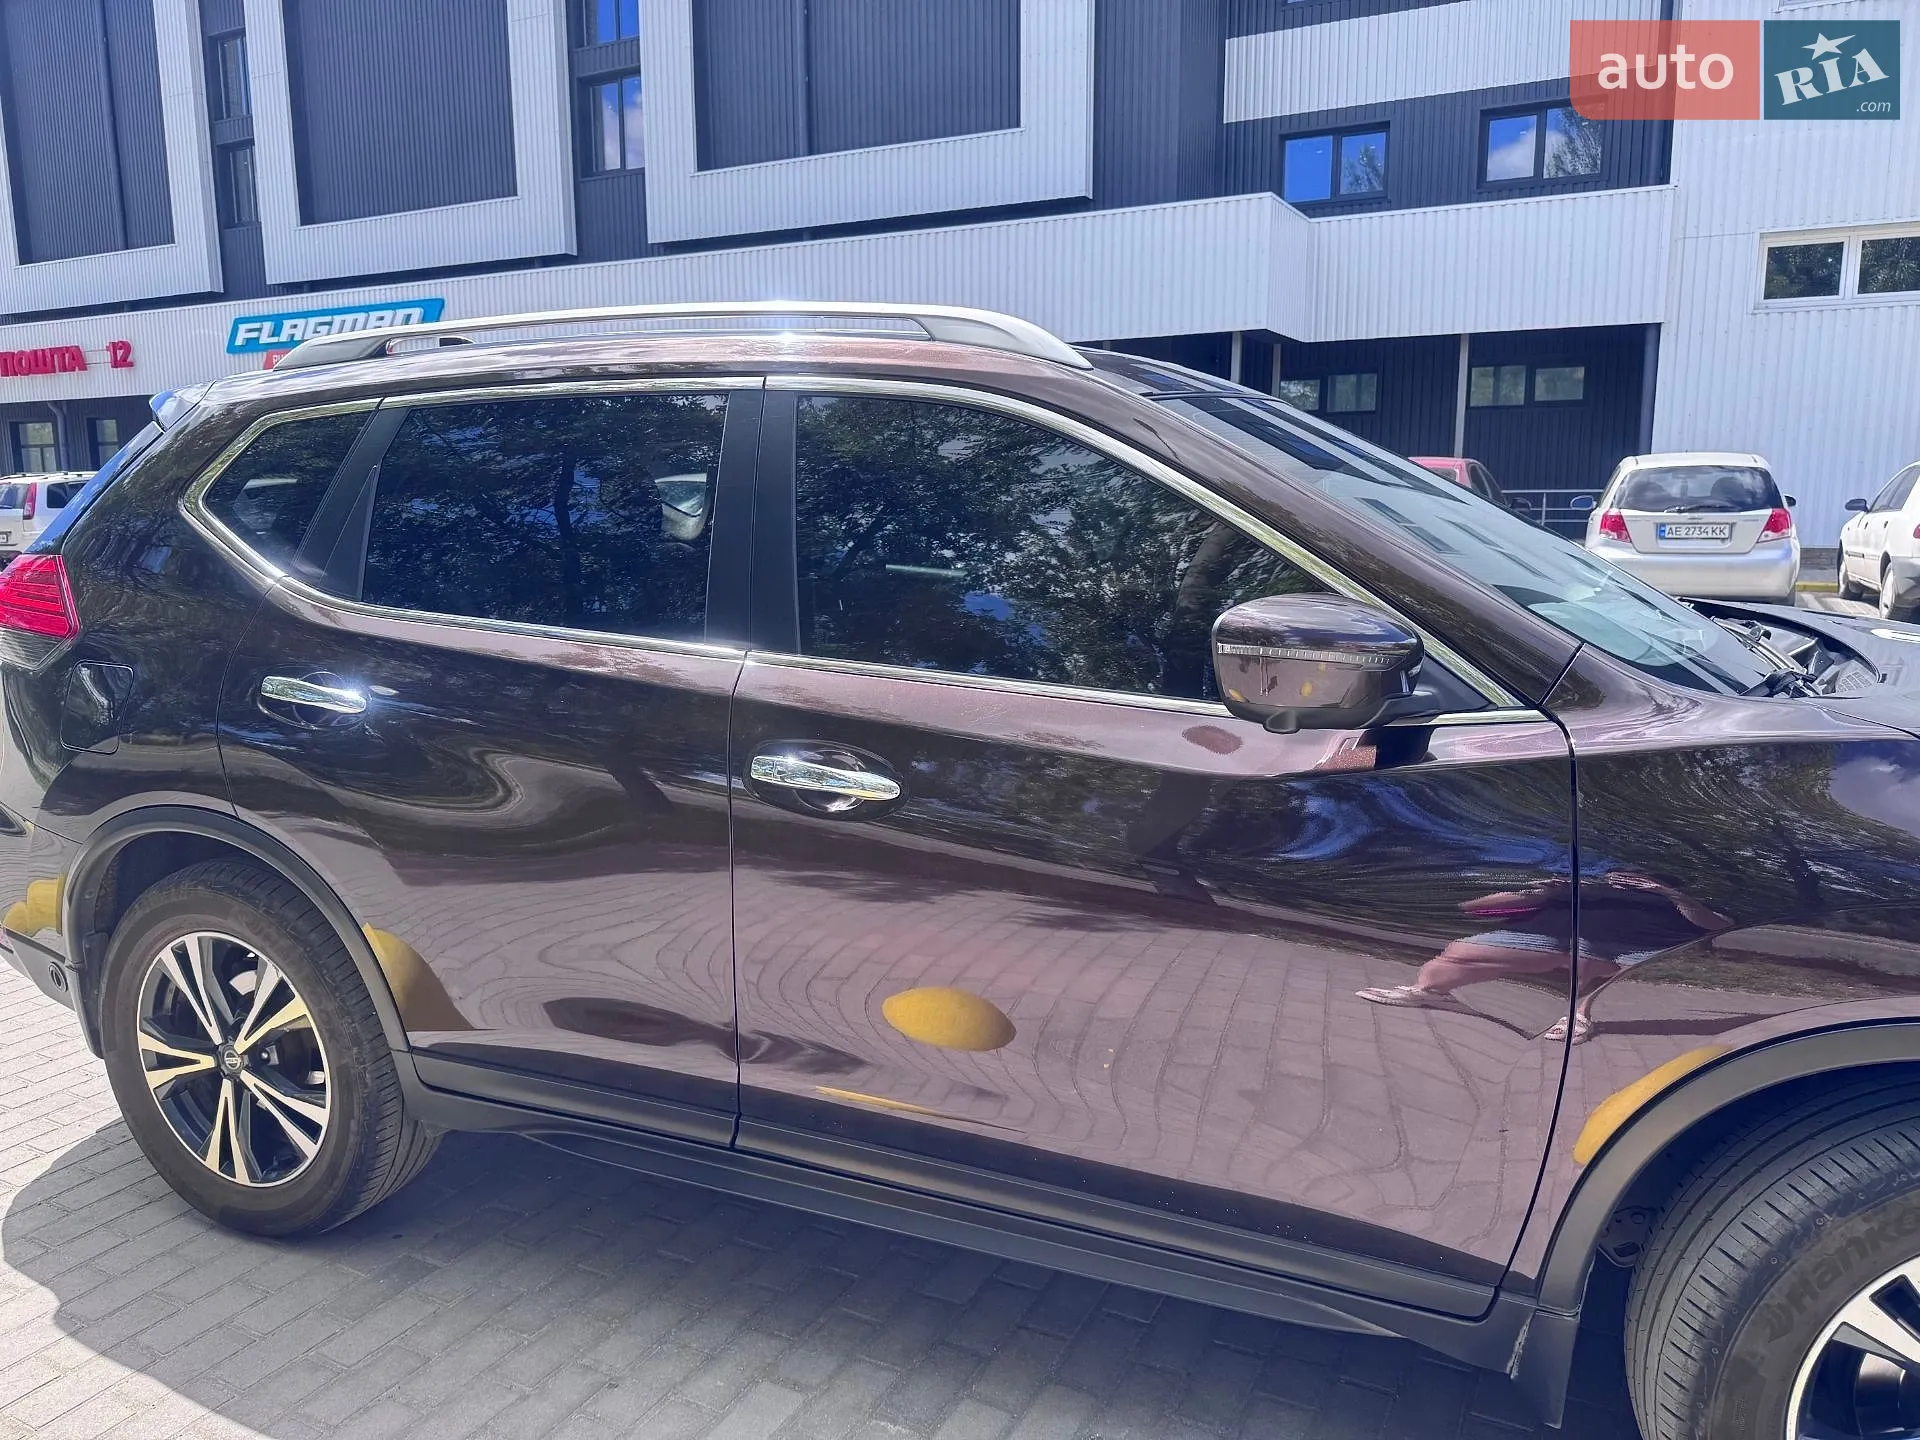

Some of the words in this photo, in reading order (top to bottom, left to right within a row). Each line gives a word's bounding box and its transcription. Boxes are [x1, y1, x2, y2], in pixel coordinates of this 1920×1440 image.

[234, 307, 424, 346] FLAGMAN
[106, 340, 134, 368] 12
[1667, 526, 1682, 536] AE
[1685, 526, 1709, 537] 2734
[1711, 526, 1726, 536] KK
